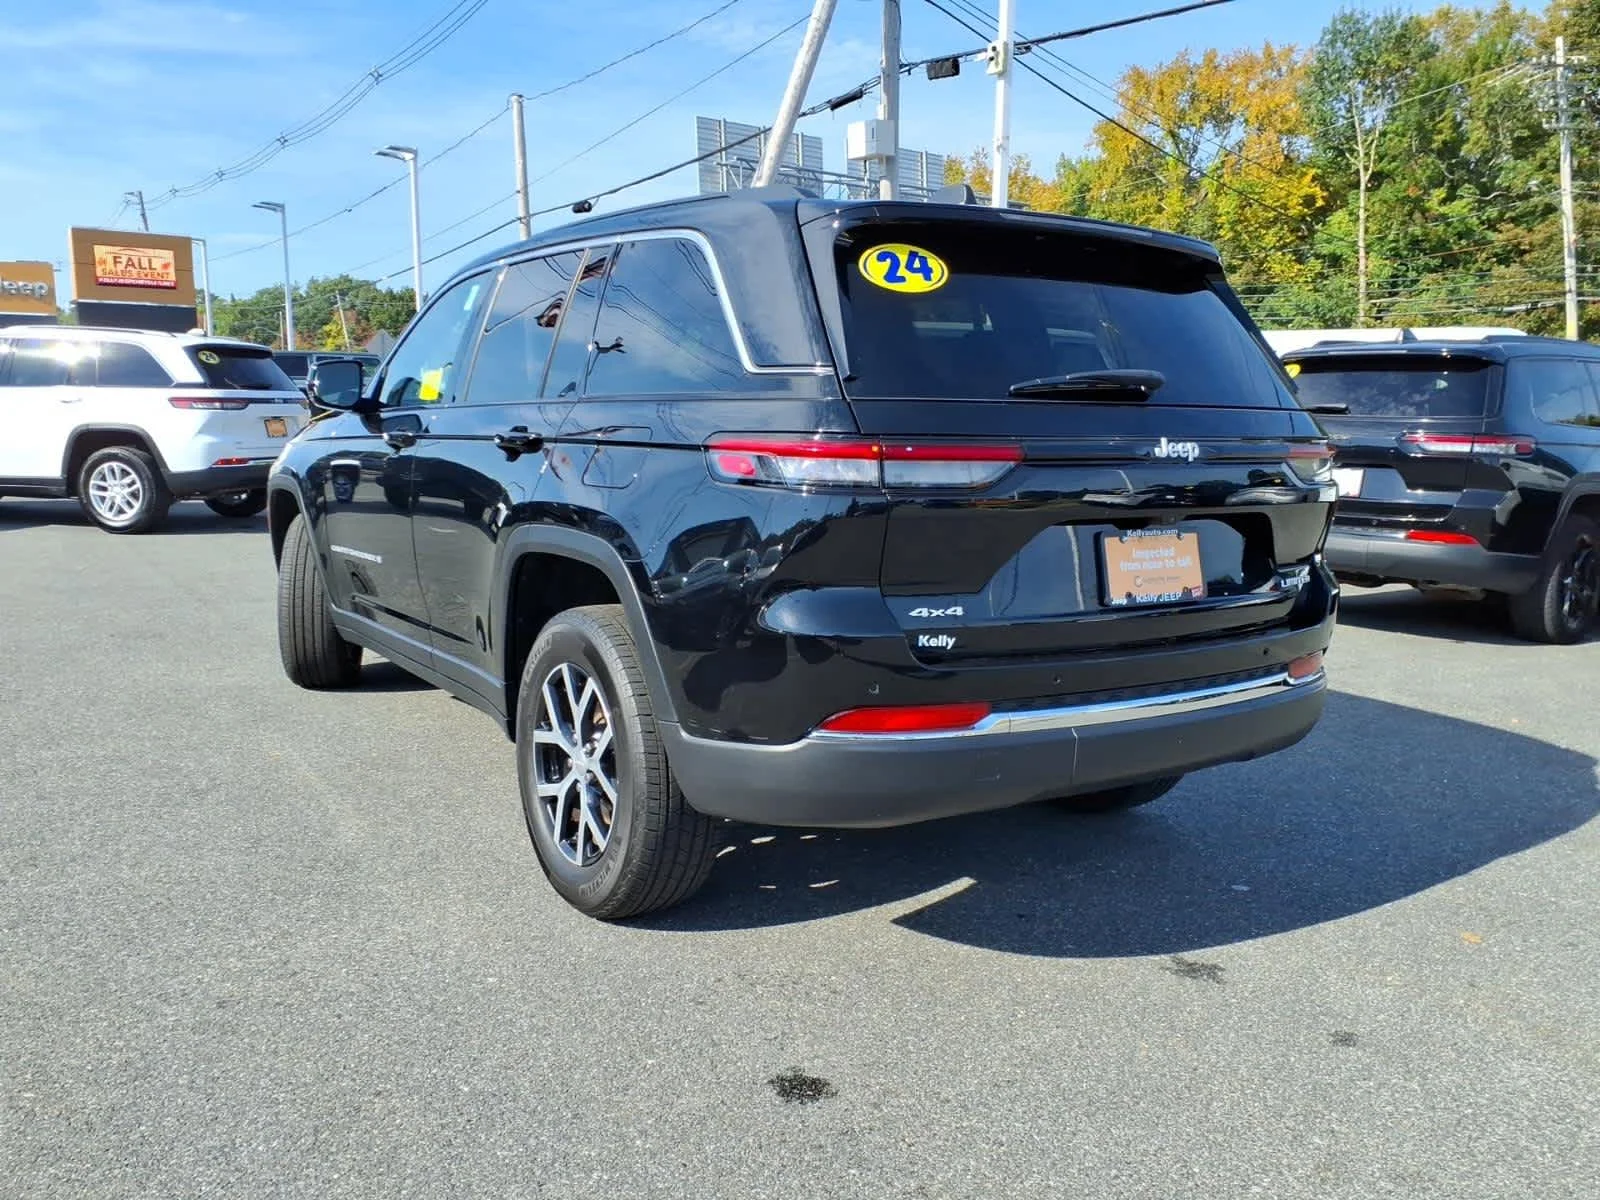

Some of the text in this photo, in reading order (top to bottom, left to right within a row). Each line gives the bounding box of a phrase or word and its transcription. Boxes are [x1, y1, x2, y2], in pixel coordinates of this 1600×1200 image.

[112, 255, 157, 271] FALL
[876, 250, 933, 283] 24
[137, 271, 170, 279] EVENT
[1153, 437, 1200, 462] Jeep
[1136, 594, 1158, 604] Kelly
[1160, 592, 1182, 602] JEEP
[908, 606, 964, 618] 4x4
[917, 634, 957, 650] Kelly
